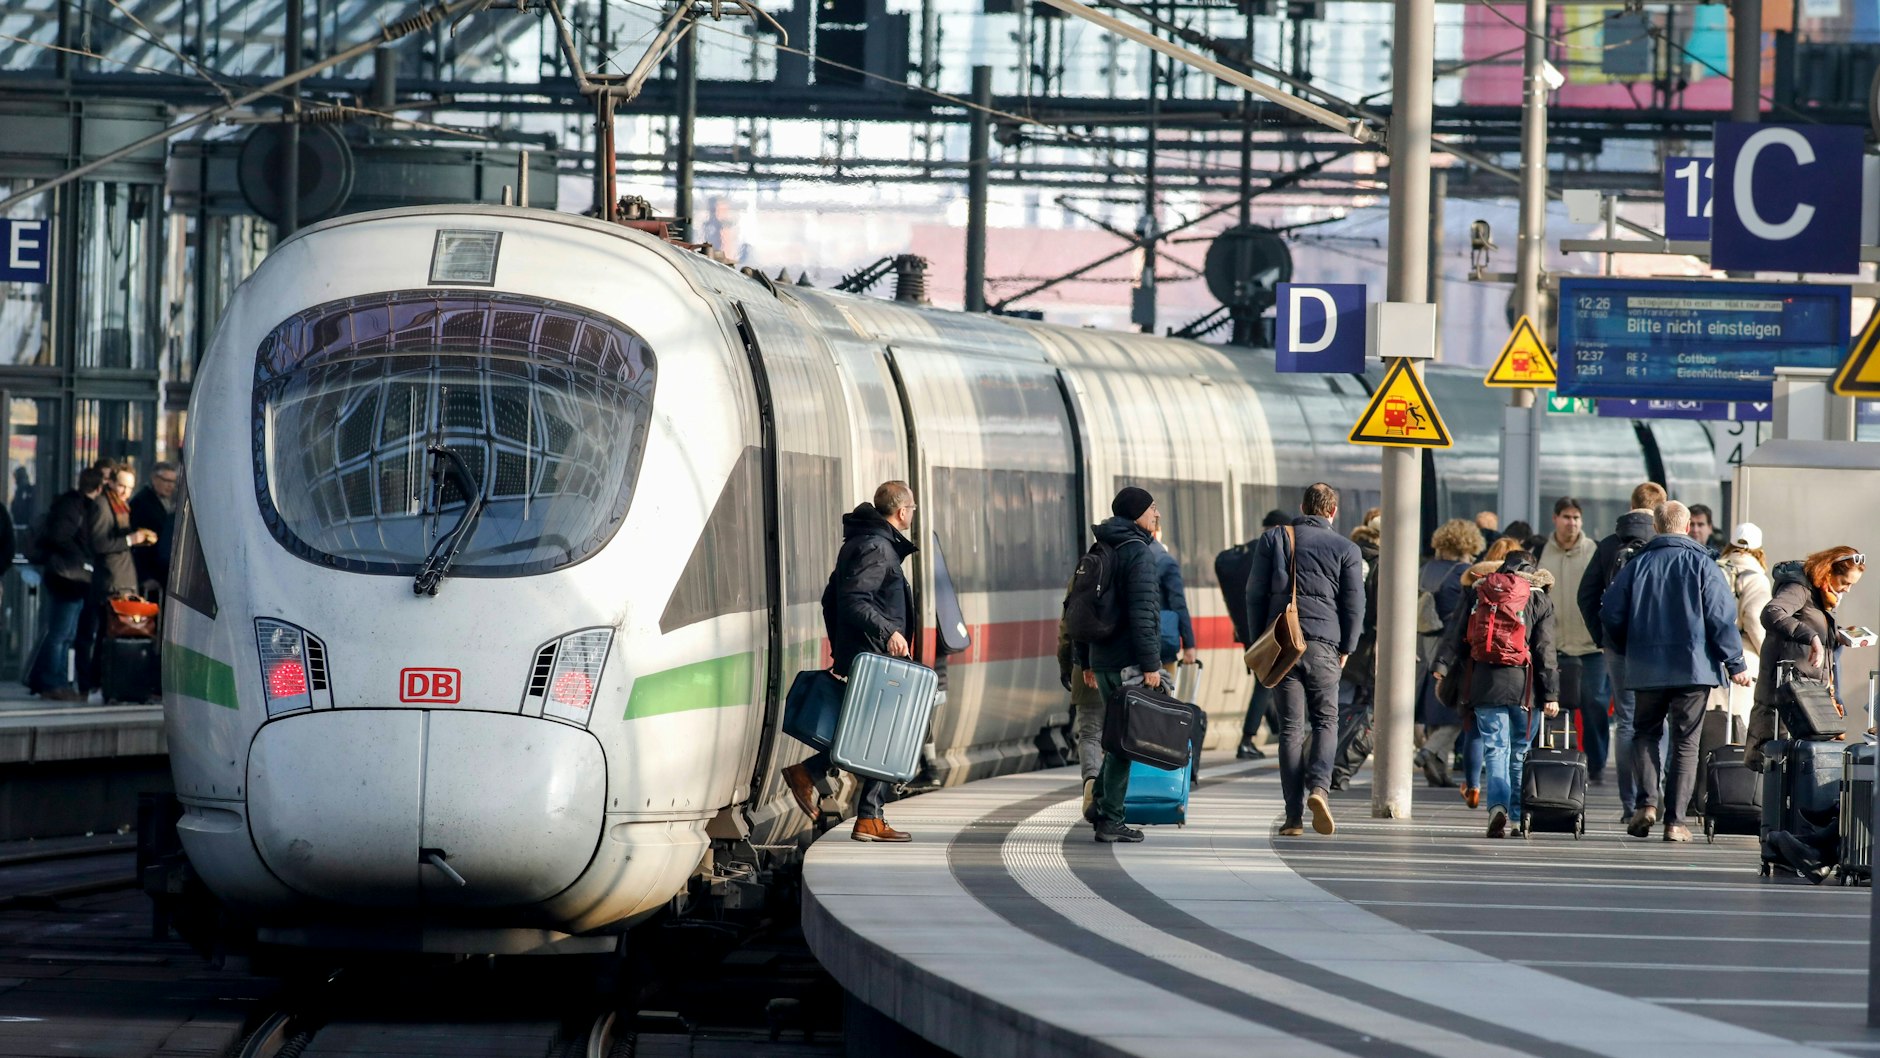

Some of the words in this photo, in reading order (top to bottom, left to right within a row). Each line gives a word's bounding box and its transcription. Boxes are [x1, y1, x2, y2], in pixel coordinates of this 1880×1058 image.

[1733, 127, 1816, 240] C
[10, 221, 41, 269] E
[1579, 297, 1611, 310] 12:26
[1289, 287, 1337, 352] D
[1627, 318, 1661, 333] Bitte
[1666, 319, 1702, 335] nicht
[1708, 321, 1781, 340] einsteigen
[1576, 350, 1604, 361] 12:37
[1626, 352, 1639, 362] RE
[1641, 352, 1648, 362] 2
[1677, 353, 1717, 365] Cottbus
[1576, 365, 1604, 375] 12:51
[1626, 366, 1639, 376] RE
[1641, 367, 1648, 376] 1
[408, 674, 453, 697] DB
